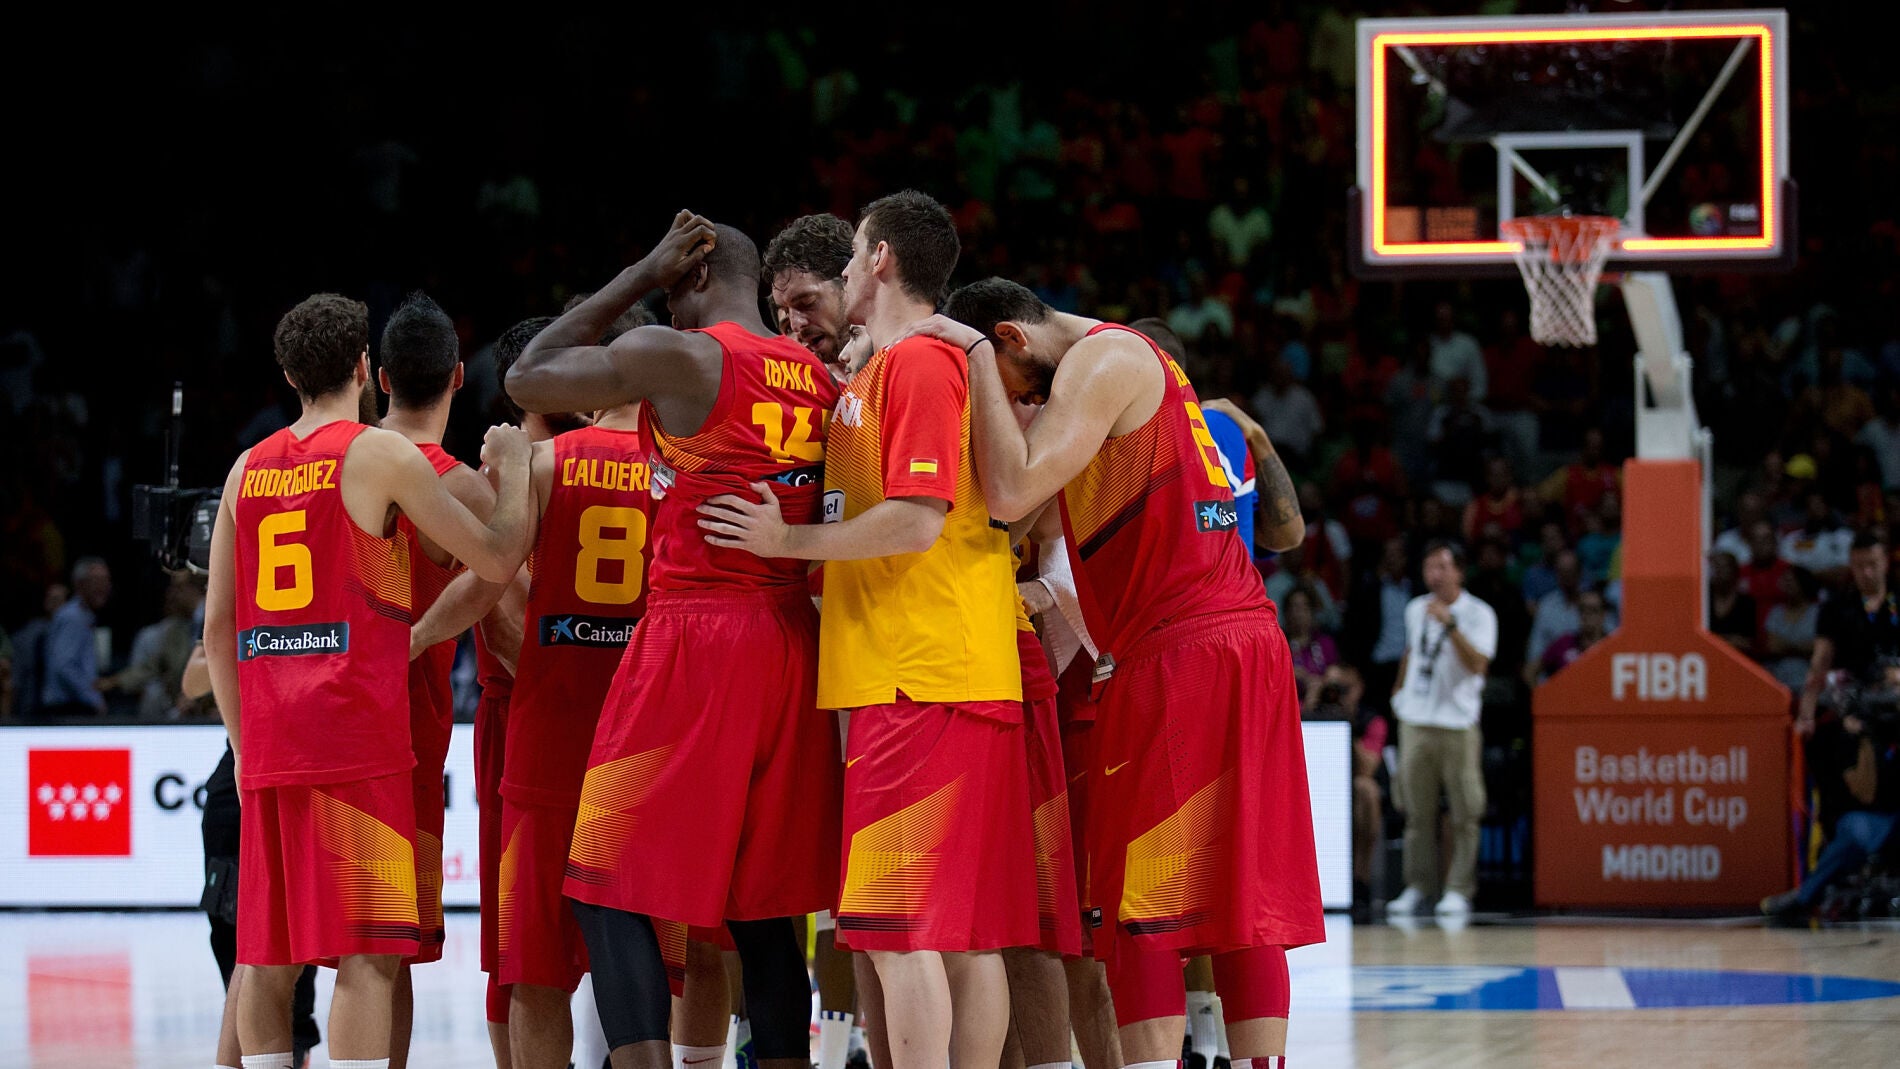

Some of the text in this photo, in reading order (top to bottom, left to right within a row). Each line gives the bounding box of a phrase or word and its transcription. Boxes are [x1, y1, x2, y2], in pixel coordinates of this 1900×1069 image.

[763, 358, 818, 395] IBAKA
[241, 459, 337, 499] RODRIGUEZ
[255, 509, 314, 612] 6
[575, 505, 647, 604] 8
[256, 629, 340, 650] CaixaBank
[1611, 653, 1708, 701] FIBA
[1574, 746, 1749, 784] Basketball
[1573, 787, 1748, 831] World Cup
[1601, 845, 1721, 881] MADRID
